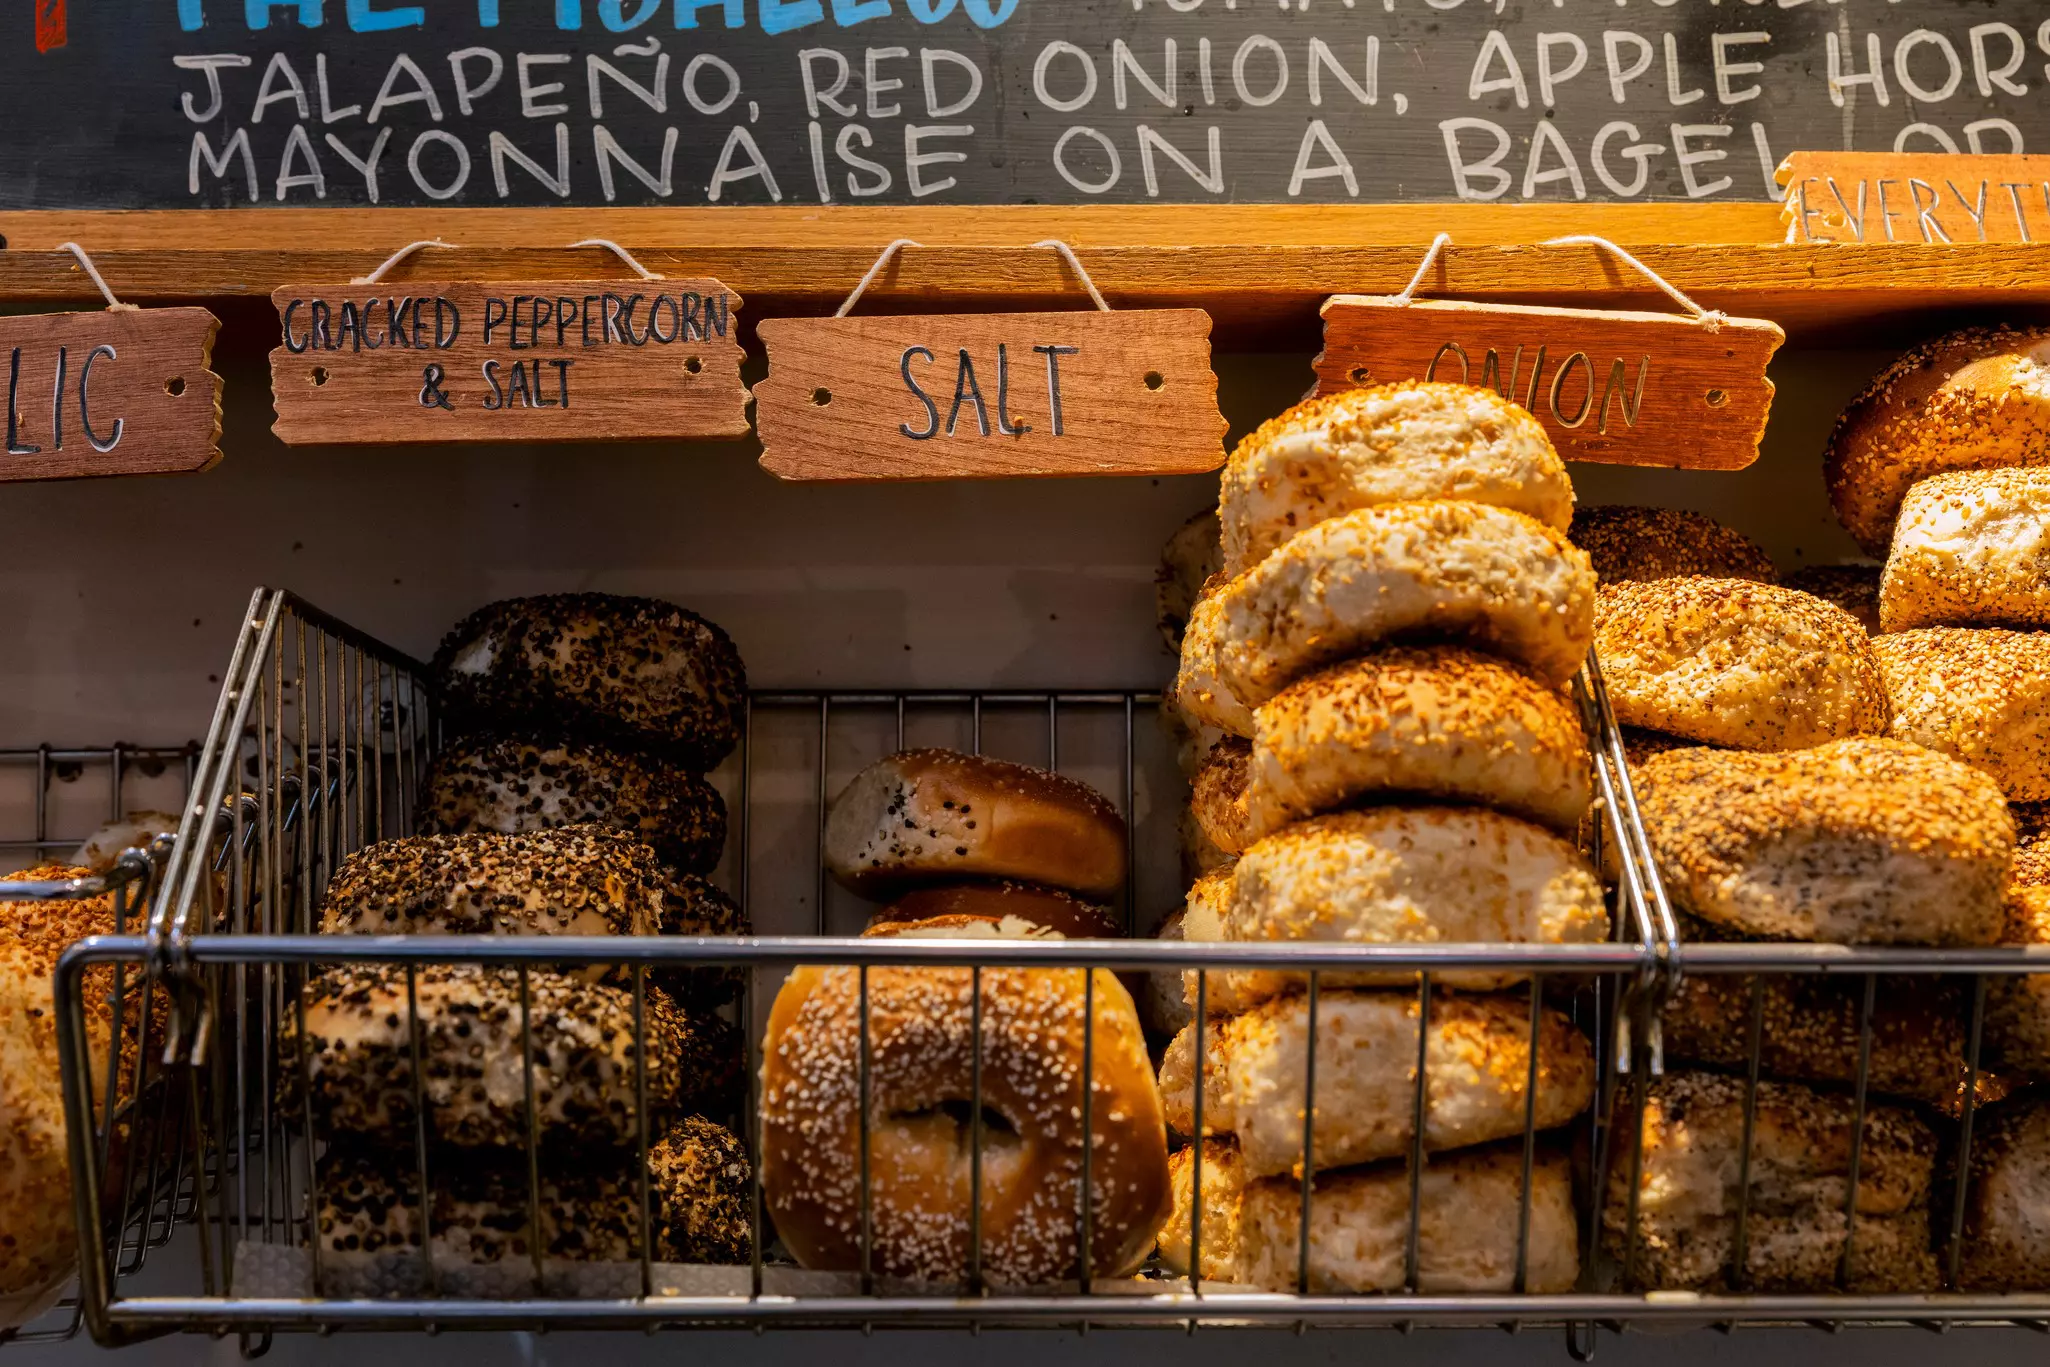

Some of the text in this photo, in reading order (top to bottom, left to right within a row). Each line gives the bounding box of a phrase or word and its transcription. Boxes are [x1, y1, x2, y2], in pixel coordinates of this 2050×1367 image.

[173, 22, 2050, 123] JALAPEÑO, RED ONION, APPLE HOR
[188, 122, 974, 204] MAYONNAISE
[1053, 125, 1223, 197] ON
[1288, 120, 1358, 196] A
[1798, 176, 2050, 243] EVERYT
[283, 292, 729, 354] CRACKED PEPPERCORN
[421, 358, 575, 411] & SALT
[899, 342, 1080, 440] SALT
